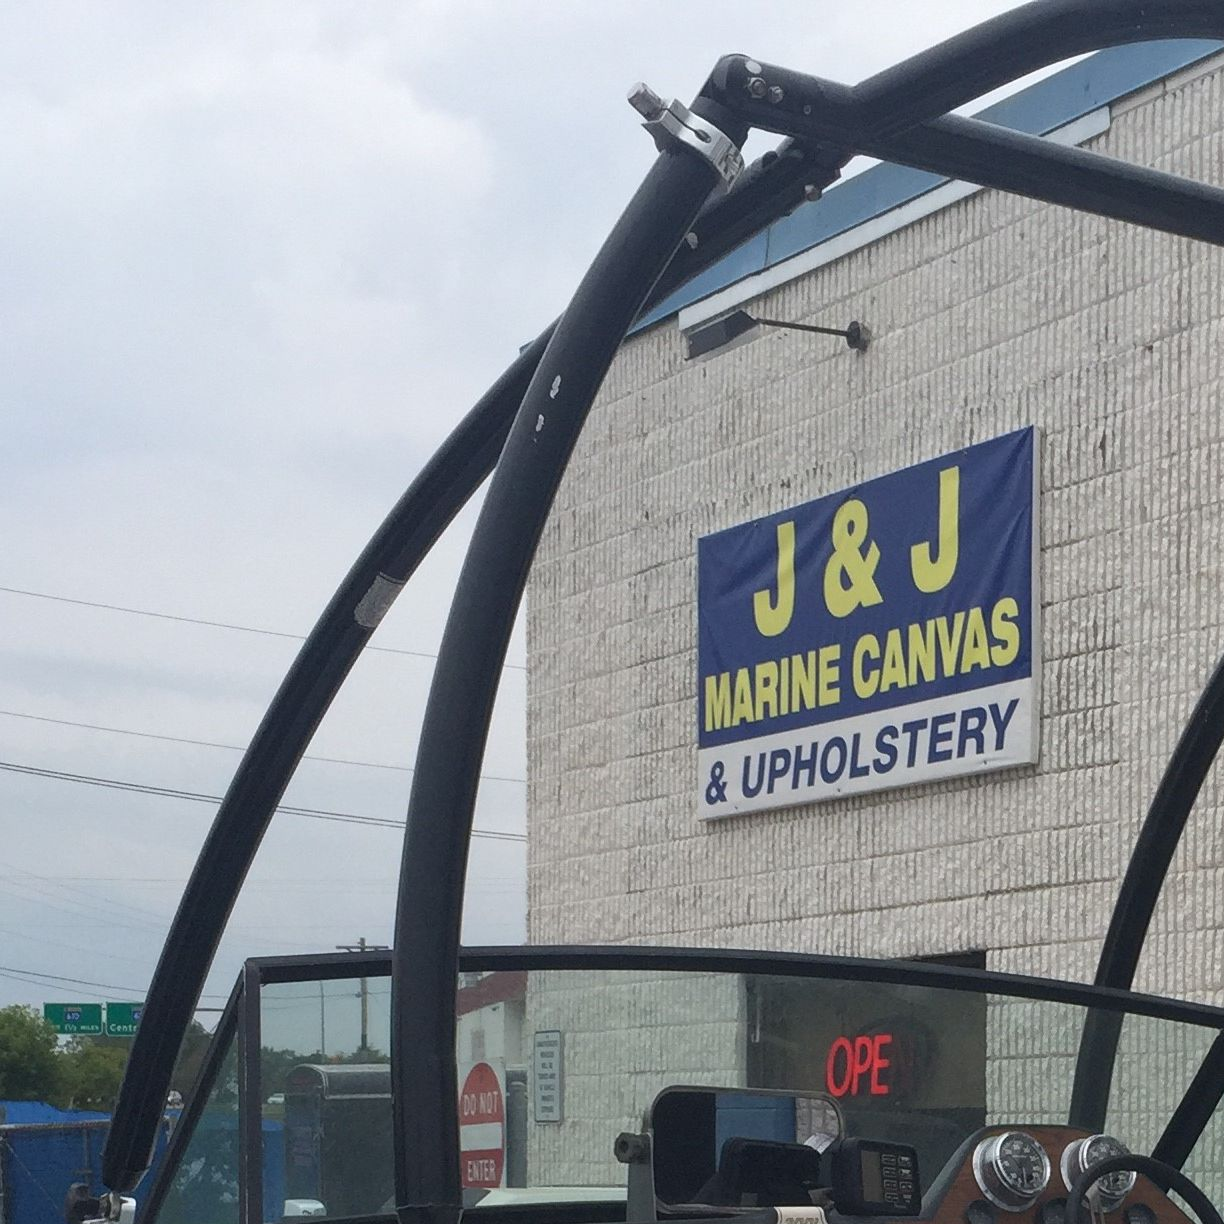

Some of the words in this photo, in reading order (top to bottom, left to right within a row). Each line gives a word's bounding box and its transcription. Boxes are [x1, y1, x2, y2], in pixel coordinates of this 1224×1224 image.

[753, 521, 795, 637] J
[824, 499, 884, 618] &
[910, 465, 960, 593] J
[704, 644, 841, 732] MARINE
[852, 597, 1020, 699] CANVAS
[705, 761, 727, 805] &
[742, 698, 1020, 799] UPHOLSTERY
[463, 1094, 477, 1116] DO
[479, 1091, 499, 1114] NOT
[467, 1159, 496, 1182] ENTER
